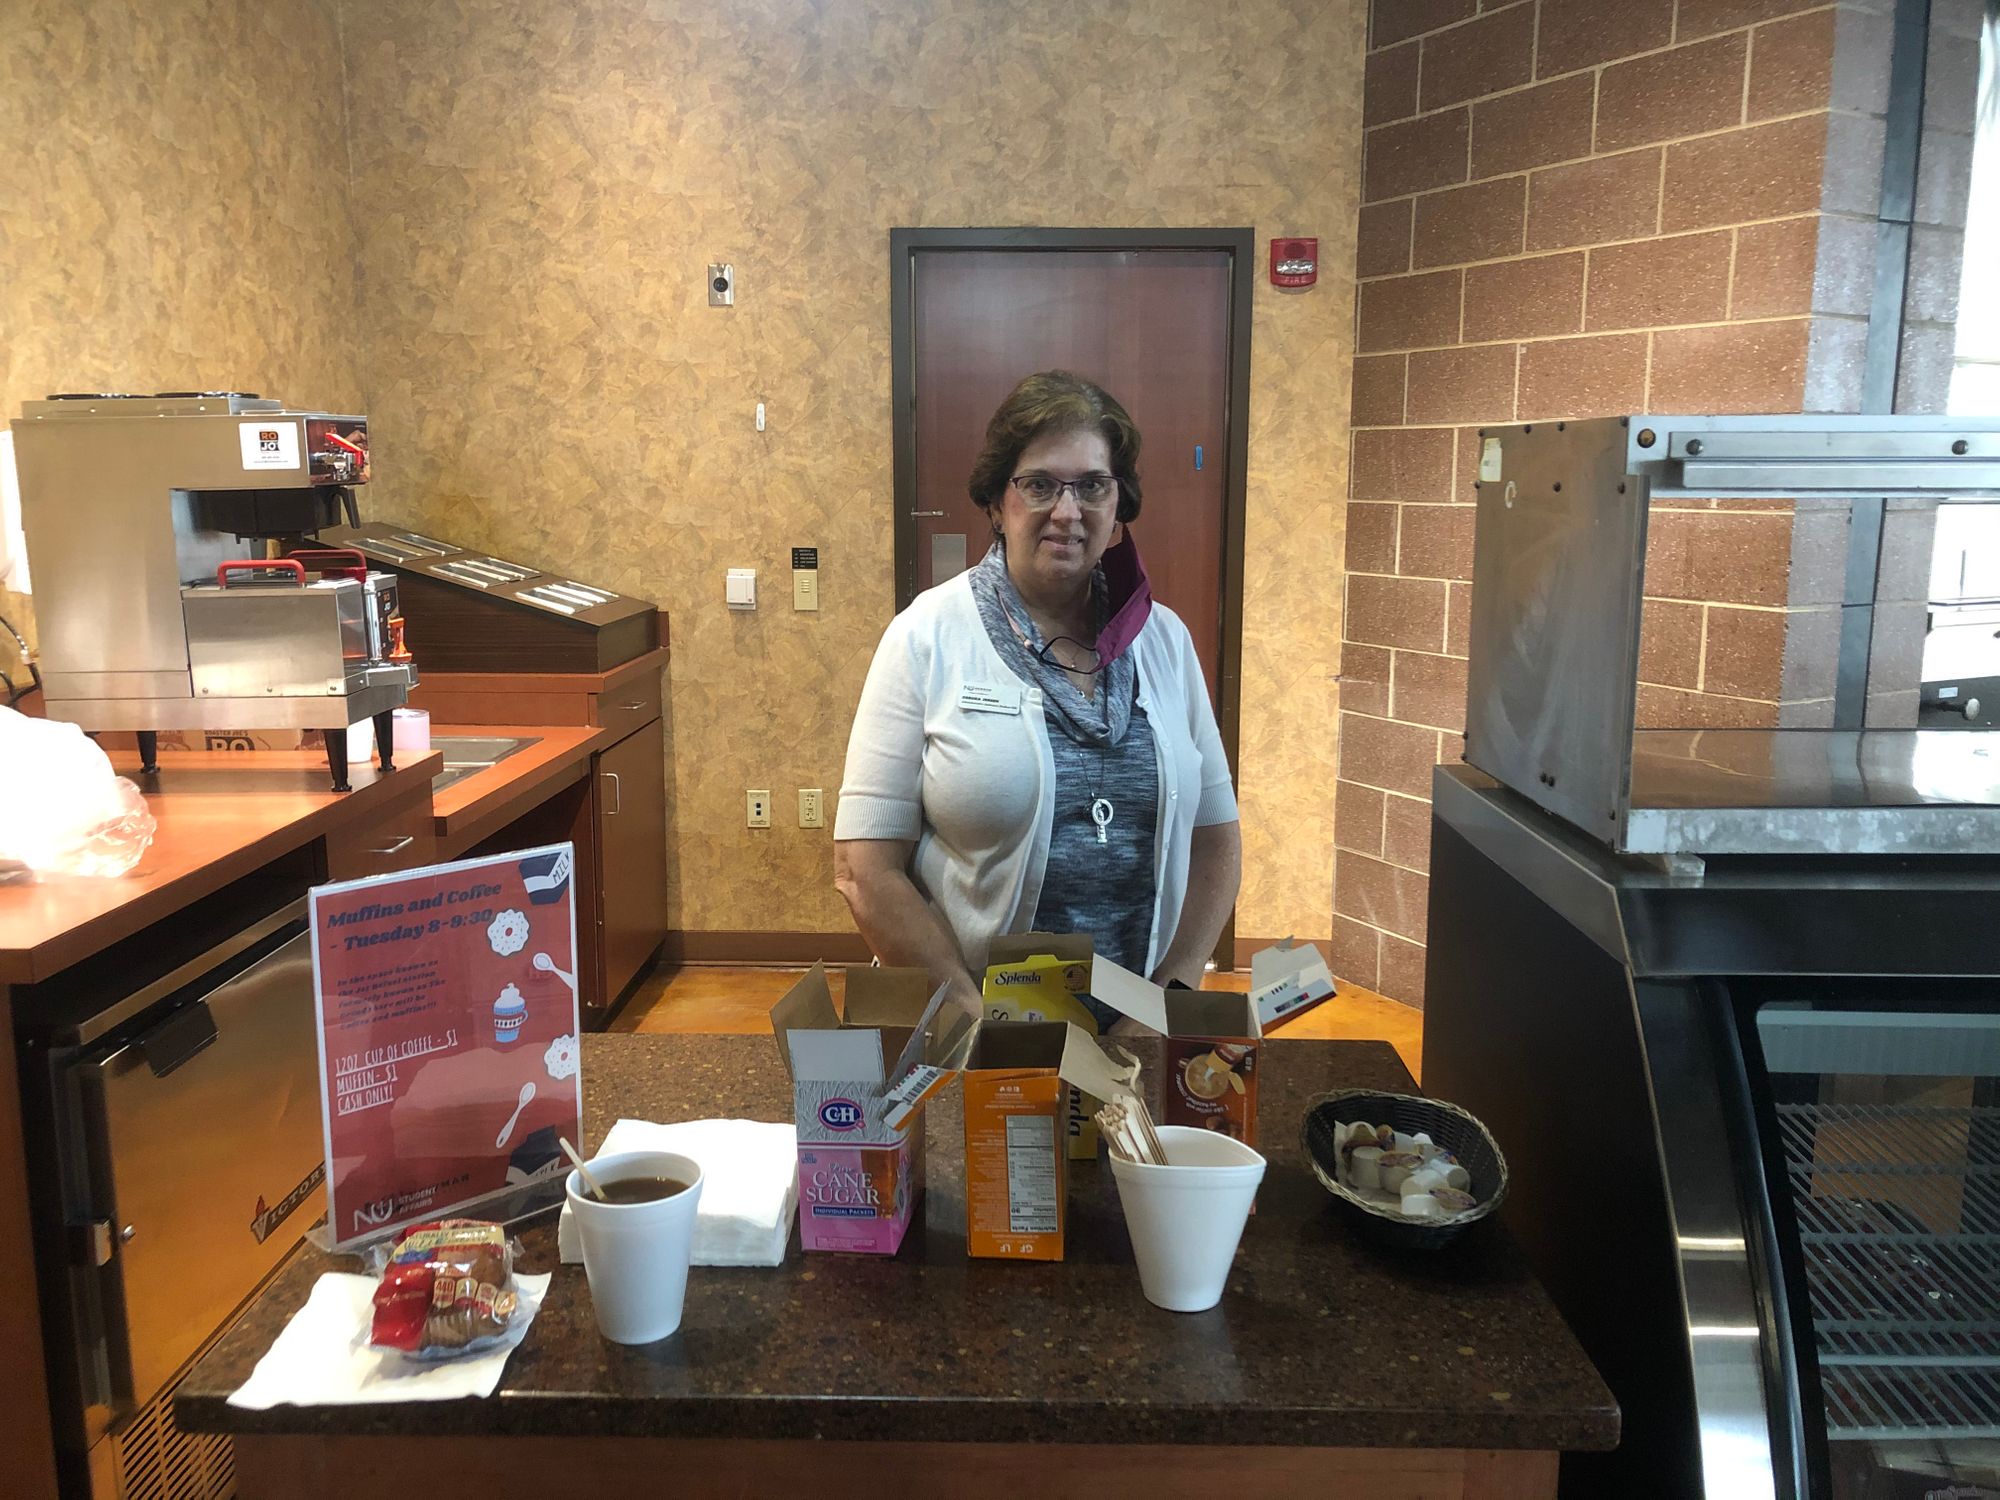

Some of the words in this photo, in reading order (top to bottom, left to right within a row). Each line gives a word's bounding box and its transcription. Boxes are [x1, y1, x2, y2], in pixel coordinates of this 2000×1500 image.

[1284, 276, 1306, 284] FIRE
[261, 432, 277, 440] RO
[327, 903, 404, 928] Muffins
[407, 892, 443, 912] and
[446, 884, 502, 904] Coffee
[344, 924, 424, 951] Tuesday
[995, 971, 1041, 986] Splenda
[365, 1047, 384, 1067] CUP
[387, 1043, 397, 1061] OF
[401, 1035, 433, 1056] COFFEE
[446, 1029, 458, 1047] $1
[385, 1064, 399, 1082] $1
[337, 1094, 362, 1115] CASH
[365, 1084, 394, 1105] ONLY!
[812, 1171, 873, 1188] CANE
[398, 1184, 438, 1202] STUDENT
[806, 1187, 881, 1204] SUGAR
[399, 1198, 434, 1214] AFFAIRS
[815, 1207, 848, 1215] INDIVIDUAL
[849, 1208, 874, 1216] PACKETS
[1019, 1243, 1034, 1254] GF
